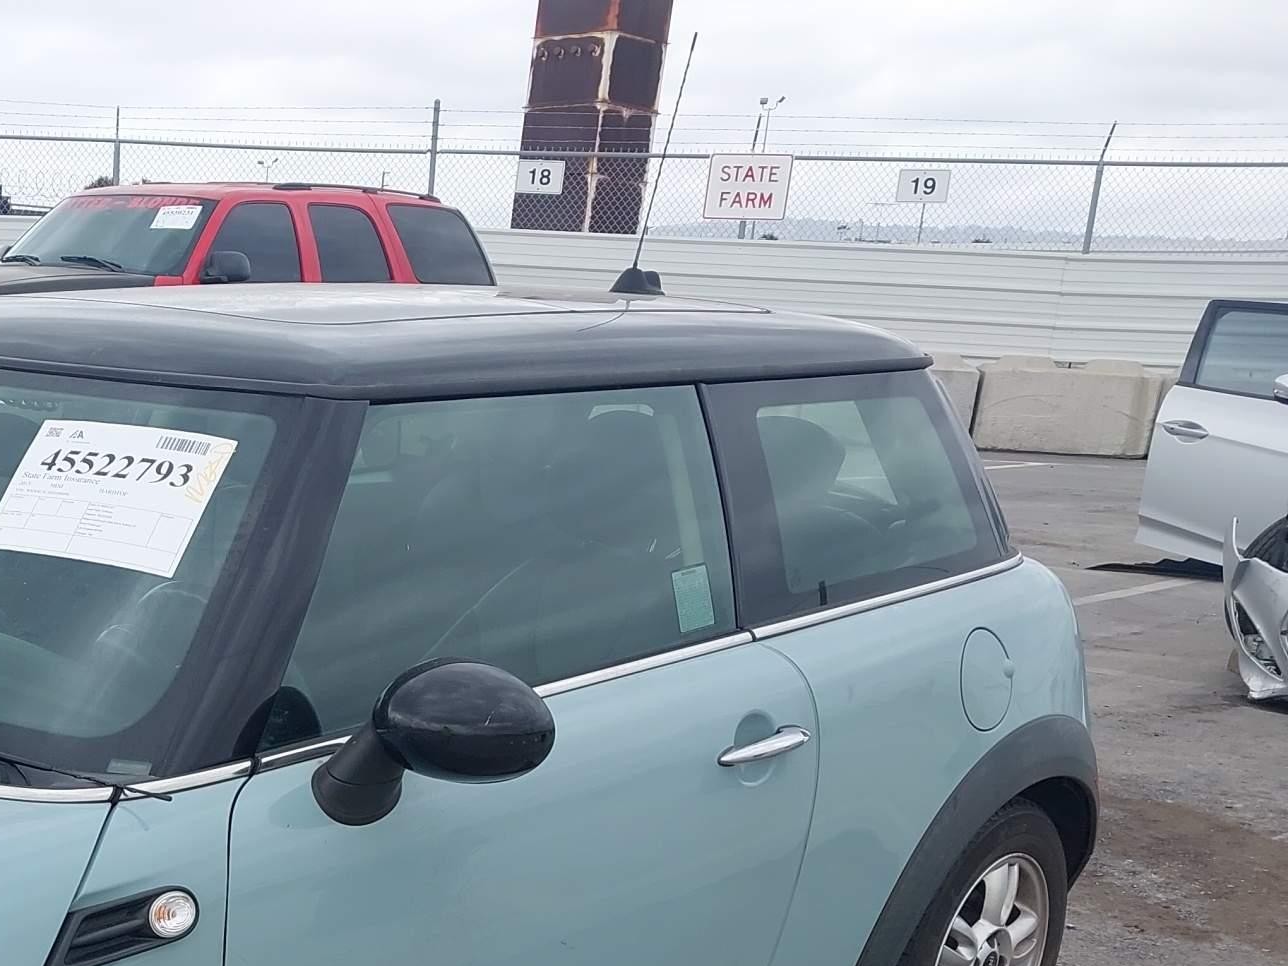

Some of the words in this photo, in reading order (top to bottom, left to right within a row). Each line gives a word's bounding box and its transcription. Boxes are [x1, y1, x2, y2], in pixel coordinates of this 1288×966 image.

[528, 167, 552, 187] 18
[719, 165, 781, 184] STATE
[910, 177, 937, 196] 19
[718, 191, 774, 210] FARM
[40, 448, 194, 488] 45522793
[22, 471, 42, 480] State
[42, 472, 62, 481] Farm
[63, 474, 101, 485] Insurance
